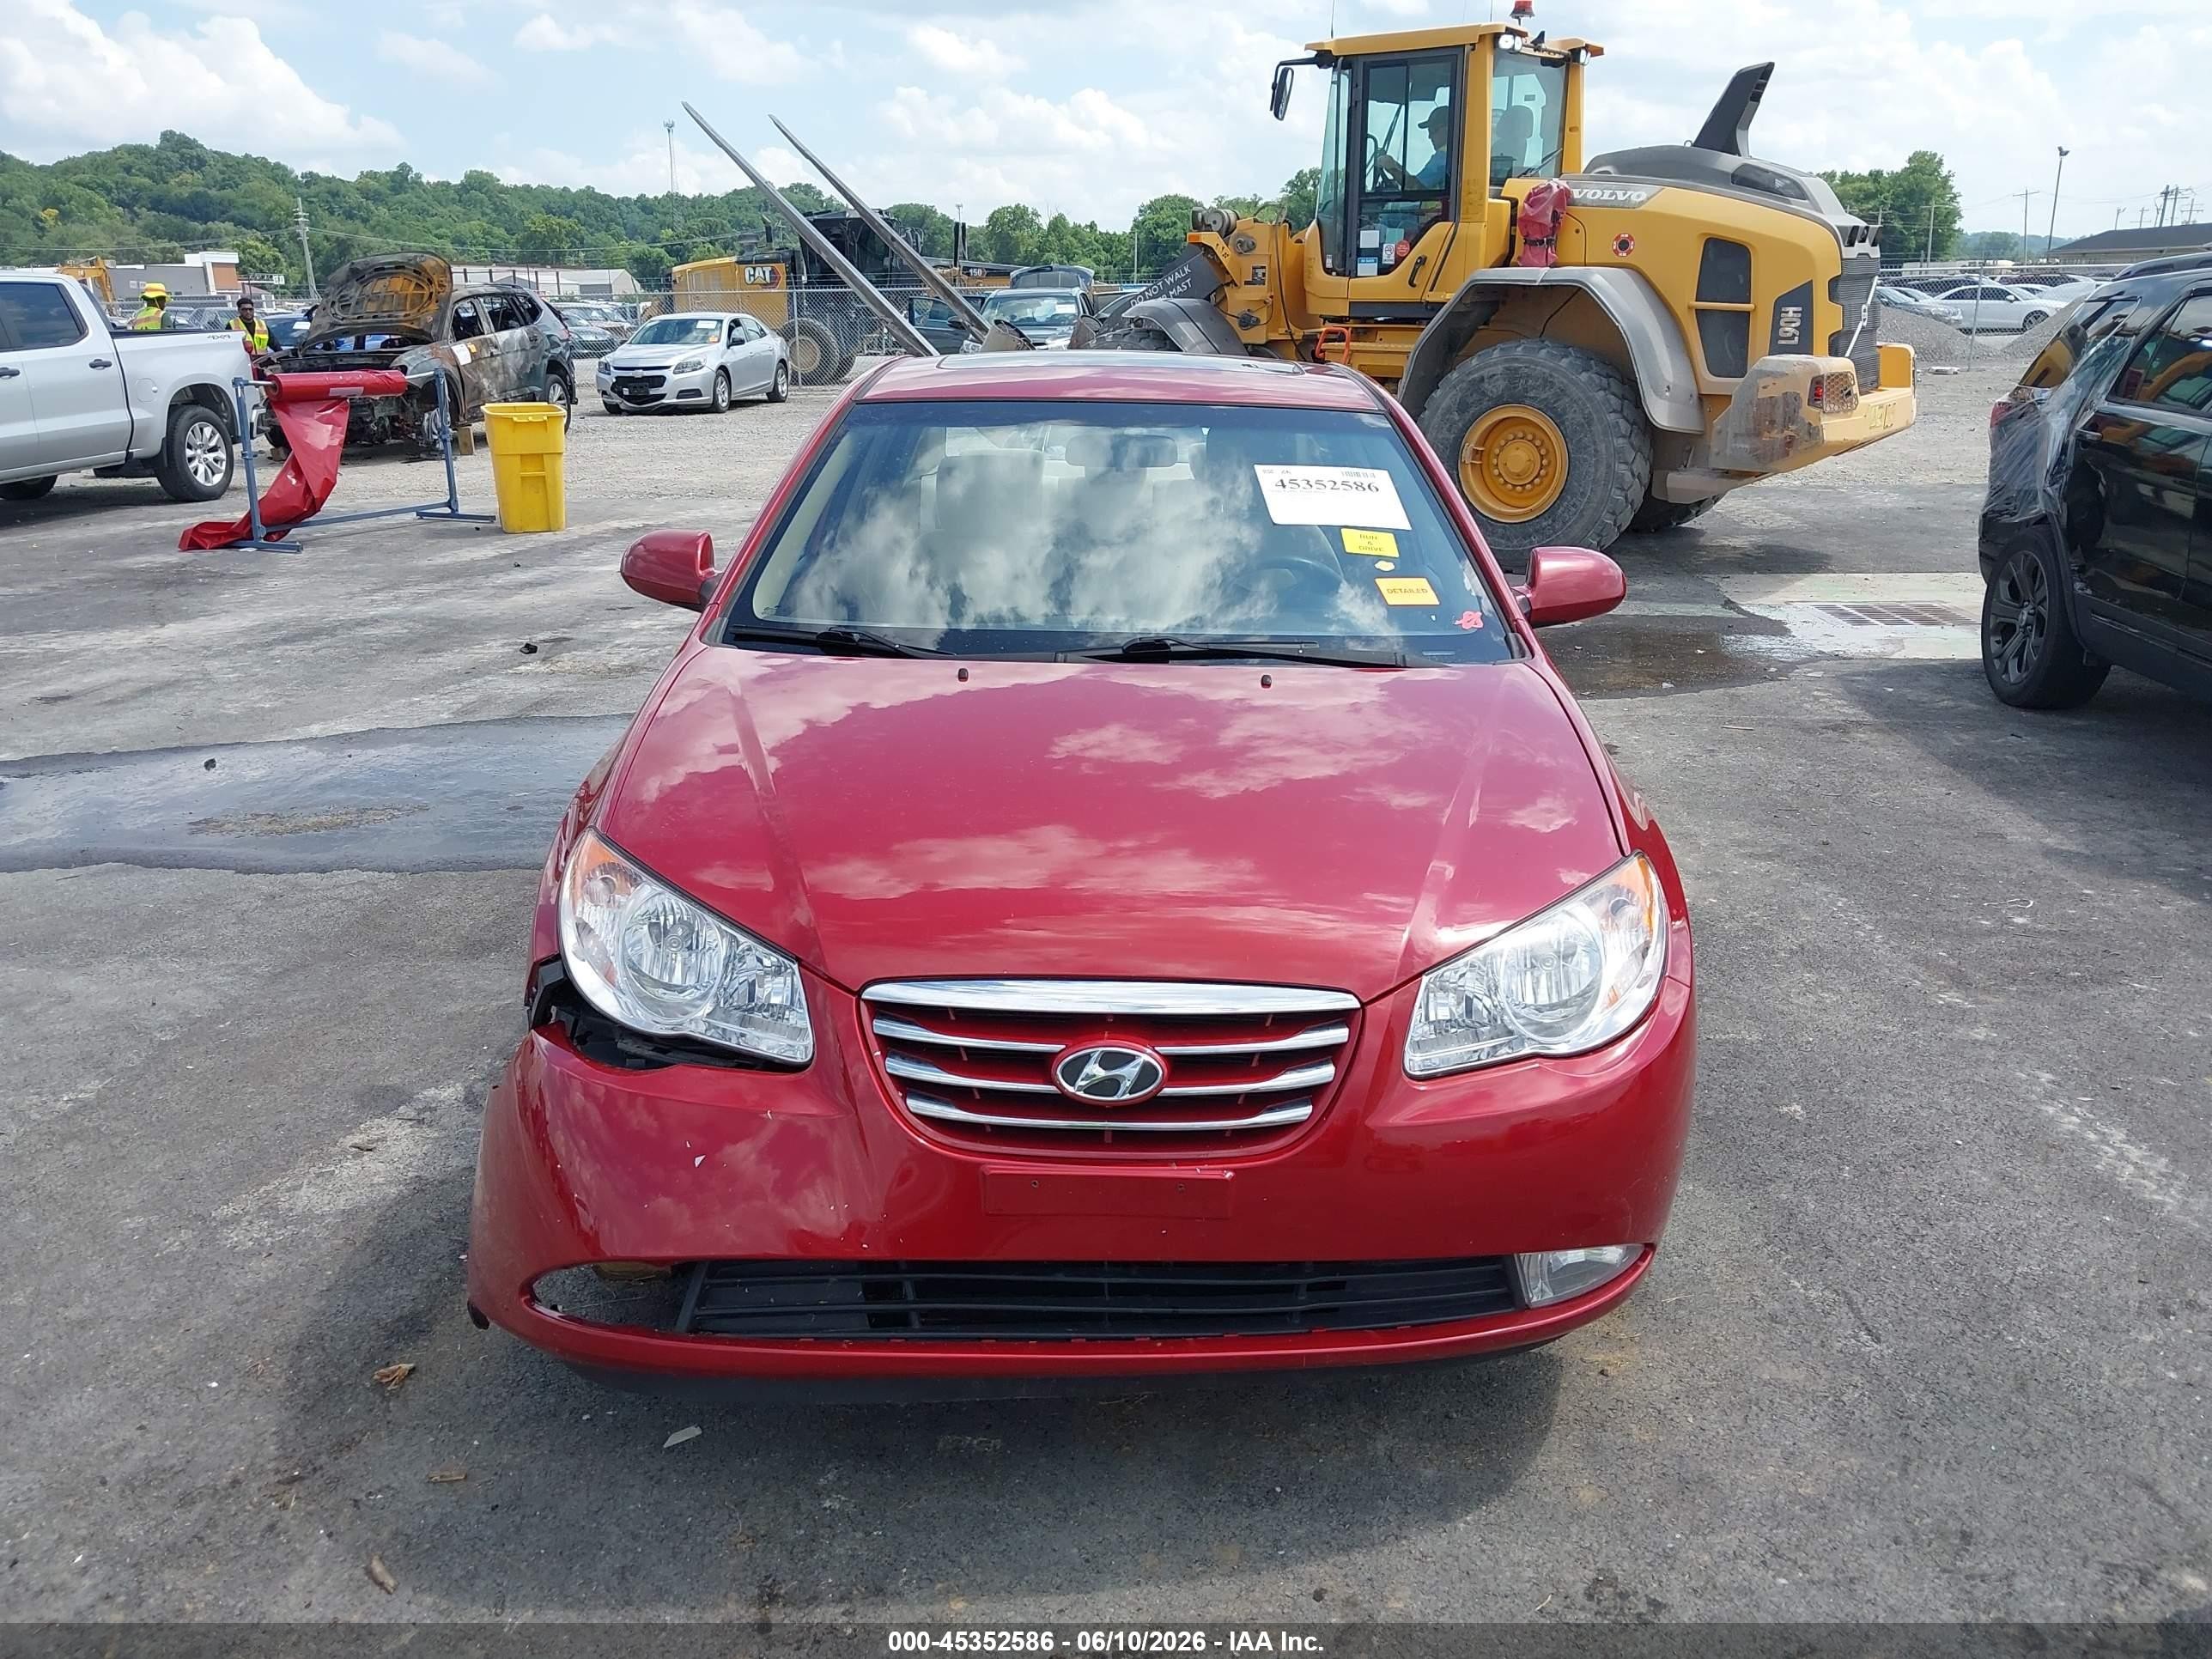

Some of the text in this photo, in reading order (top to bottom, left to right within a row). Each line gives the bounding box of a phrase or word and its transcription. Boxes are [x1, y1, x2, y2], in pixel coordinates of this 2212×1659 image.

[1571, 188, 1646, 201] VOLVO
[744, 266, 772, 284] CAT
[969, 268, 982, 276] 150
[1130, 264, 1192, 307] DO NOT WALK
[1169, 278, 1192, 299] MAST
[1778, 307, 1802, 345] L90H
[1274, 478, 1380, 493] 45352586
